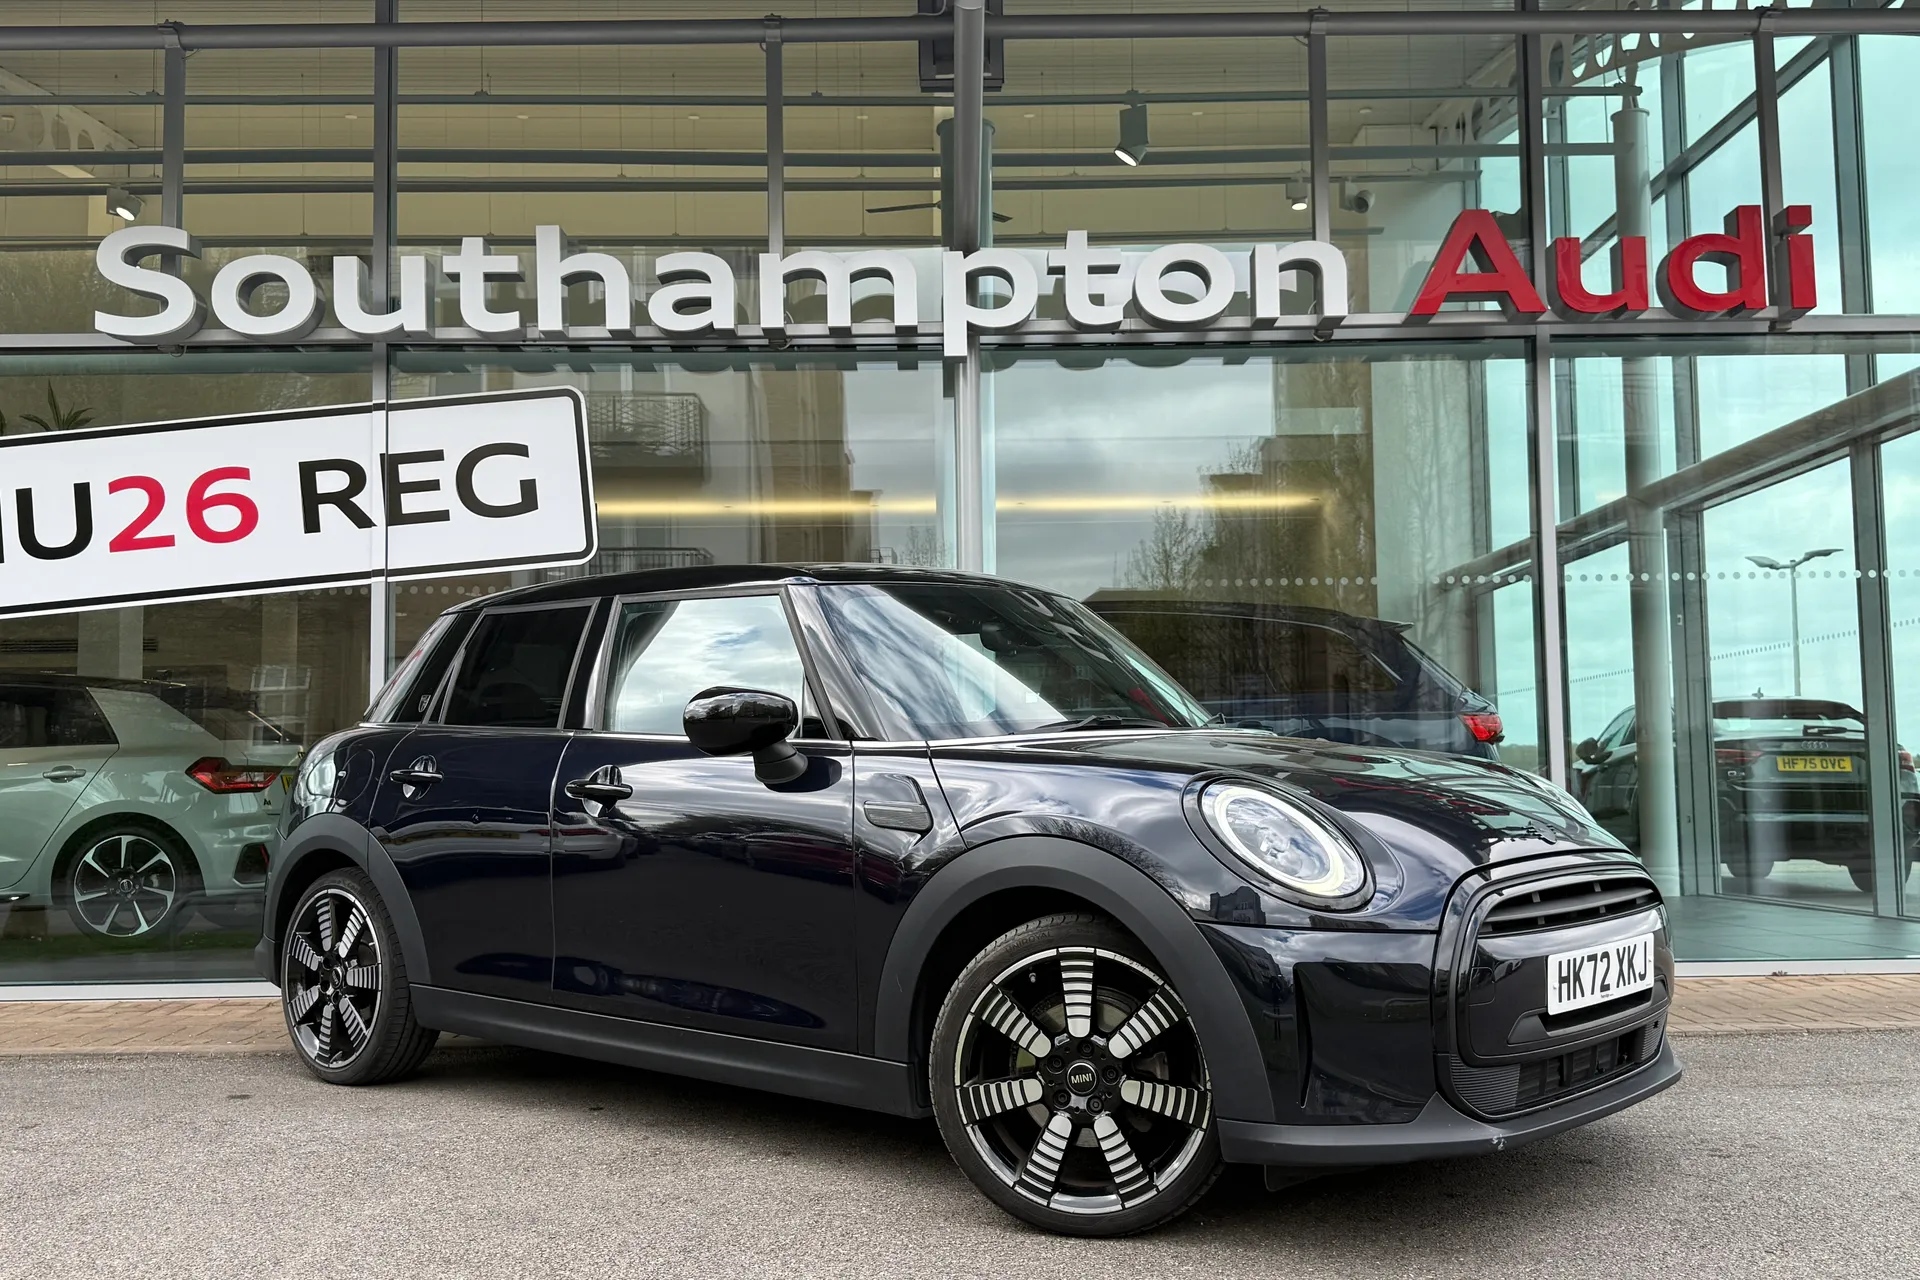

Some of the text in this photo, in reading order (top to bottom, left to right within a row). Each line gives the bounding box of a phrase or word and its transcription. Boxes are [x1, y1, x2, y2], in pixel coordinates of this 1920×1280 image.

[94, 204, 1817, 358] Southampton Audi
[0, 442, 539, 564] U26 REG
[1782, 757, 1817, 769] HF75
[1006, 930, 1055, 952] UNIROYAL
[1558, 941, 1647, 1003] HK72 XKJ
[1070, 1072, 1093, 1084] MINI
